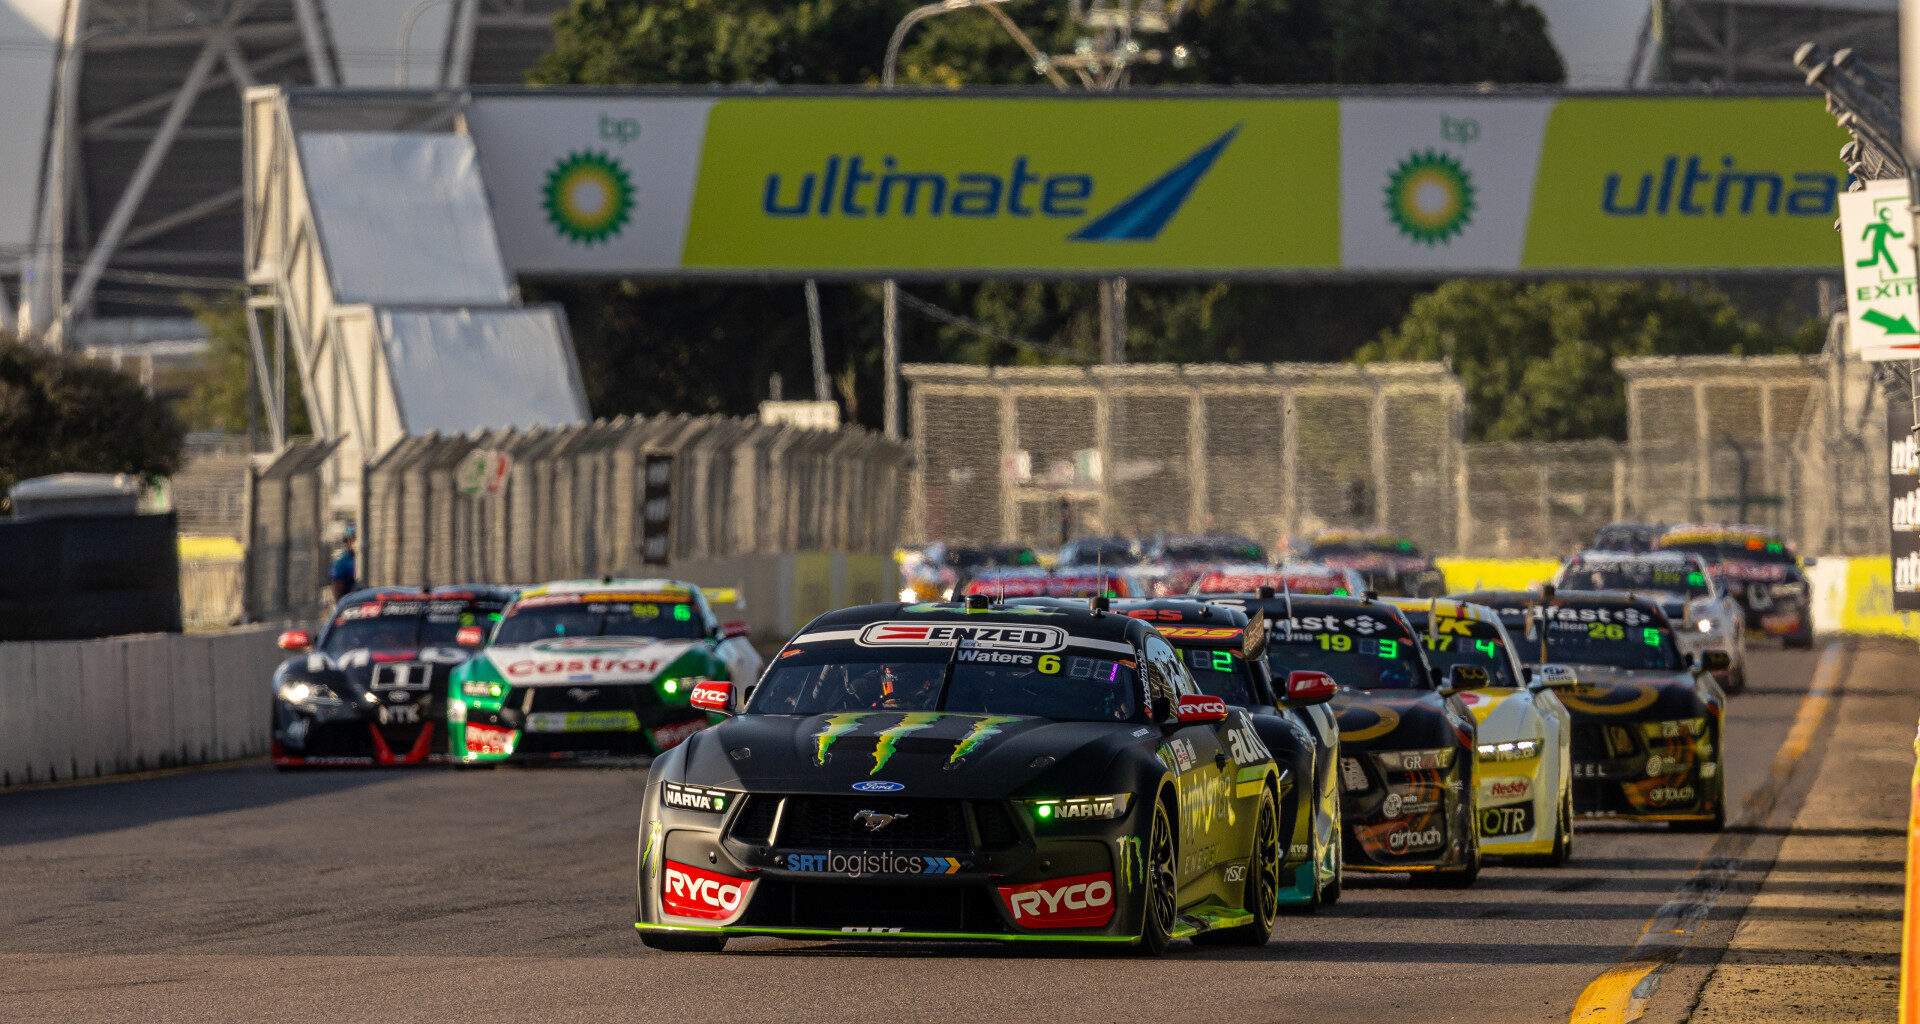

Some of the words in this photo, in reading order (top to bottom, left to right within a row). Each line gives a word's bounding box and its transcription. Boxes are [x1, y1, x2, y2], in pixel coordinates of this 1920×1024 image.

[602, 114, 640, 141] bp
[1441, 113, 1480, 142] bp
[764, 154, 1094, 218] ultimate
[1602, 154, 1854, 217] ultima
[1857, 282, 1913, 300] EXIT
[929, 627, 1047, 644] ENZED
[1547, 620, 1587, 632] Allen
[1588, 622, 1624, 640] 26
[1643, 627, 1660, 648] 5
[1270, 631, 1314, 642] ayne
[1315, 633, 1352, 652] 19
[1378, 638, 1397, 659] 3
[1476, 638, 1495, 659] 4
[507, 658, 659, 677] Castrol
[957, 649, 1034, 665] Waters
[1037, 654, 1061, 674] 6
[1212, 649, 1233, 673] 2
[692, 686, 728, 702] RYCO
[1178, 702, 1225, 715] RYCO
[862, 780, 894, 792] Ford
[1491, 781, 1530, 798] Reddy
[667, 790, 709, 810] NARVA
[1054, 801, 1115, 819] NARVA
[1483, 807, 1525, 835] OTR
[1389, 828, 1441, 849] airtouch
[787, 849, 922, 879] SRTlogistics
[665, 867, 742, 911] RYCO
[1011, 880, 1112, 919] RYCO
